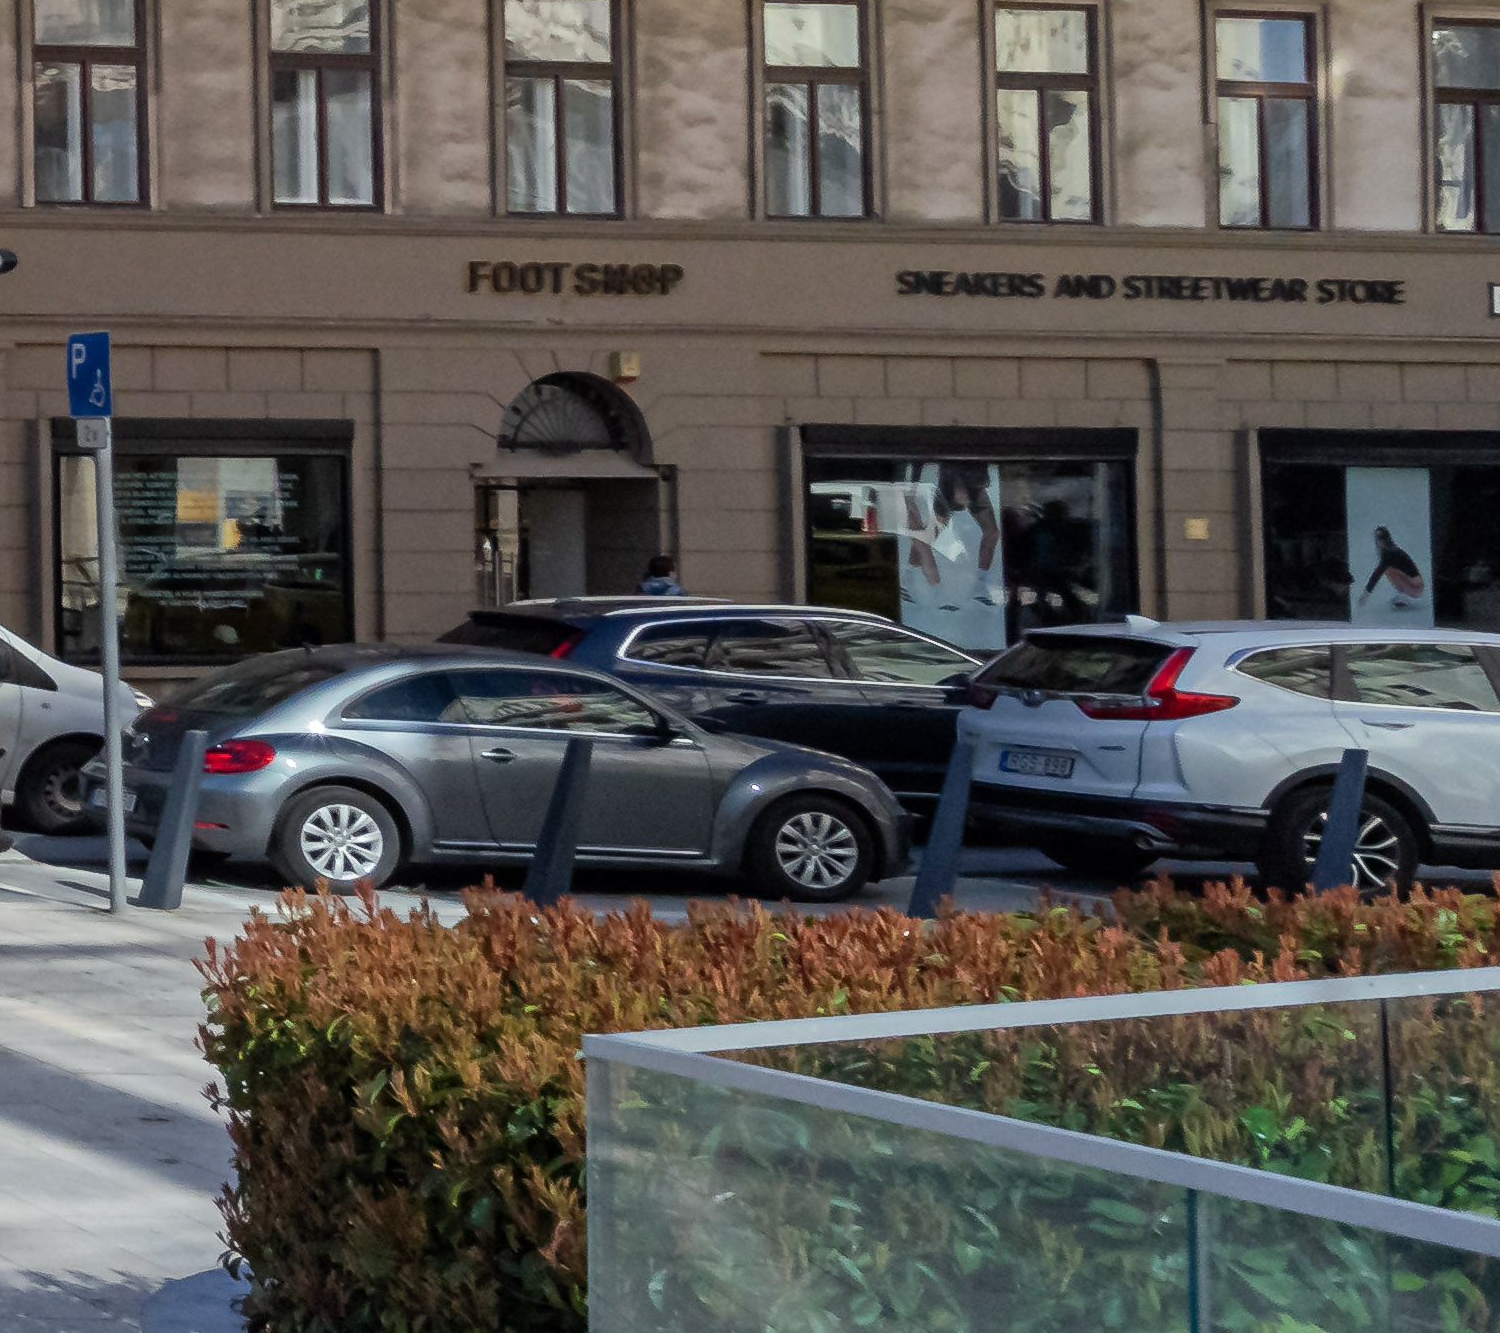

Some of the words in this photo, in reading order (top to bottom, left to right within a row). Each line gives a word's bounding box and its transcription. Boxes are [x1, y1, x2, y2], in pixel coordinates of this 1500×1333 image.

[896, 270, 1045, 298] SNEAKERS
[1053, 274, 1117, 300] AND
[1122, 275, 1309, 302] STREETWEAR
[1315, 278, 1406, 304] STORE
[71, 343, 86, 380] P
